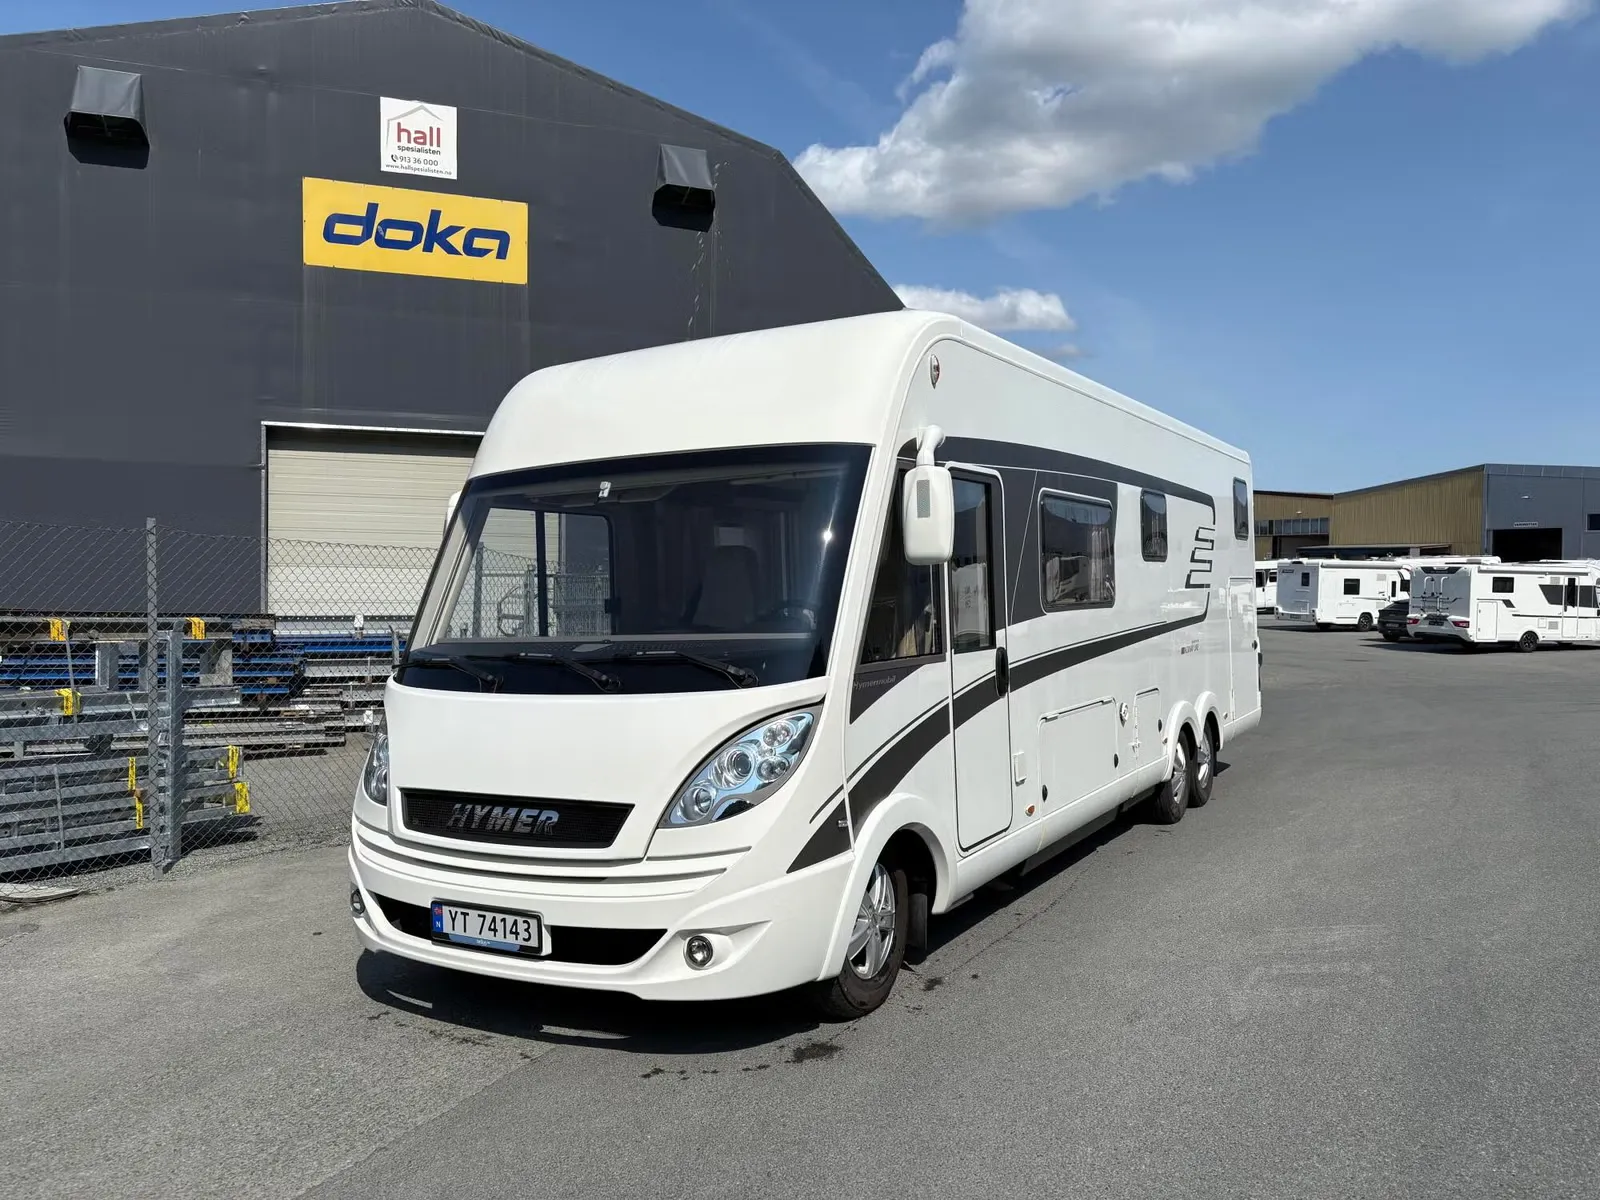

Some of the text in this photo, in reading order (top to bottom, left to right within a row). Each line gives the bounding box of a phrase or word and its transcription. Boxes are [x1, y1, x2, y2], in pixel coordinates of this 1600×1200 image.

[397, 121, 441, 148] hall
[397, 145, 441, 156] spesialisten
[385, 163, 453, 176] www.hallspesialisten.no
[399, 155, 439, 167] 913 36 000
[322, 202, 511, 260] doka
[446, 803, 560, 836] HYMER
[435, 920, 441, 928] N
[448, 909, 532, 943] YT 74143
